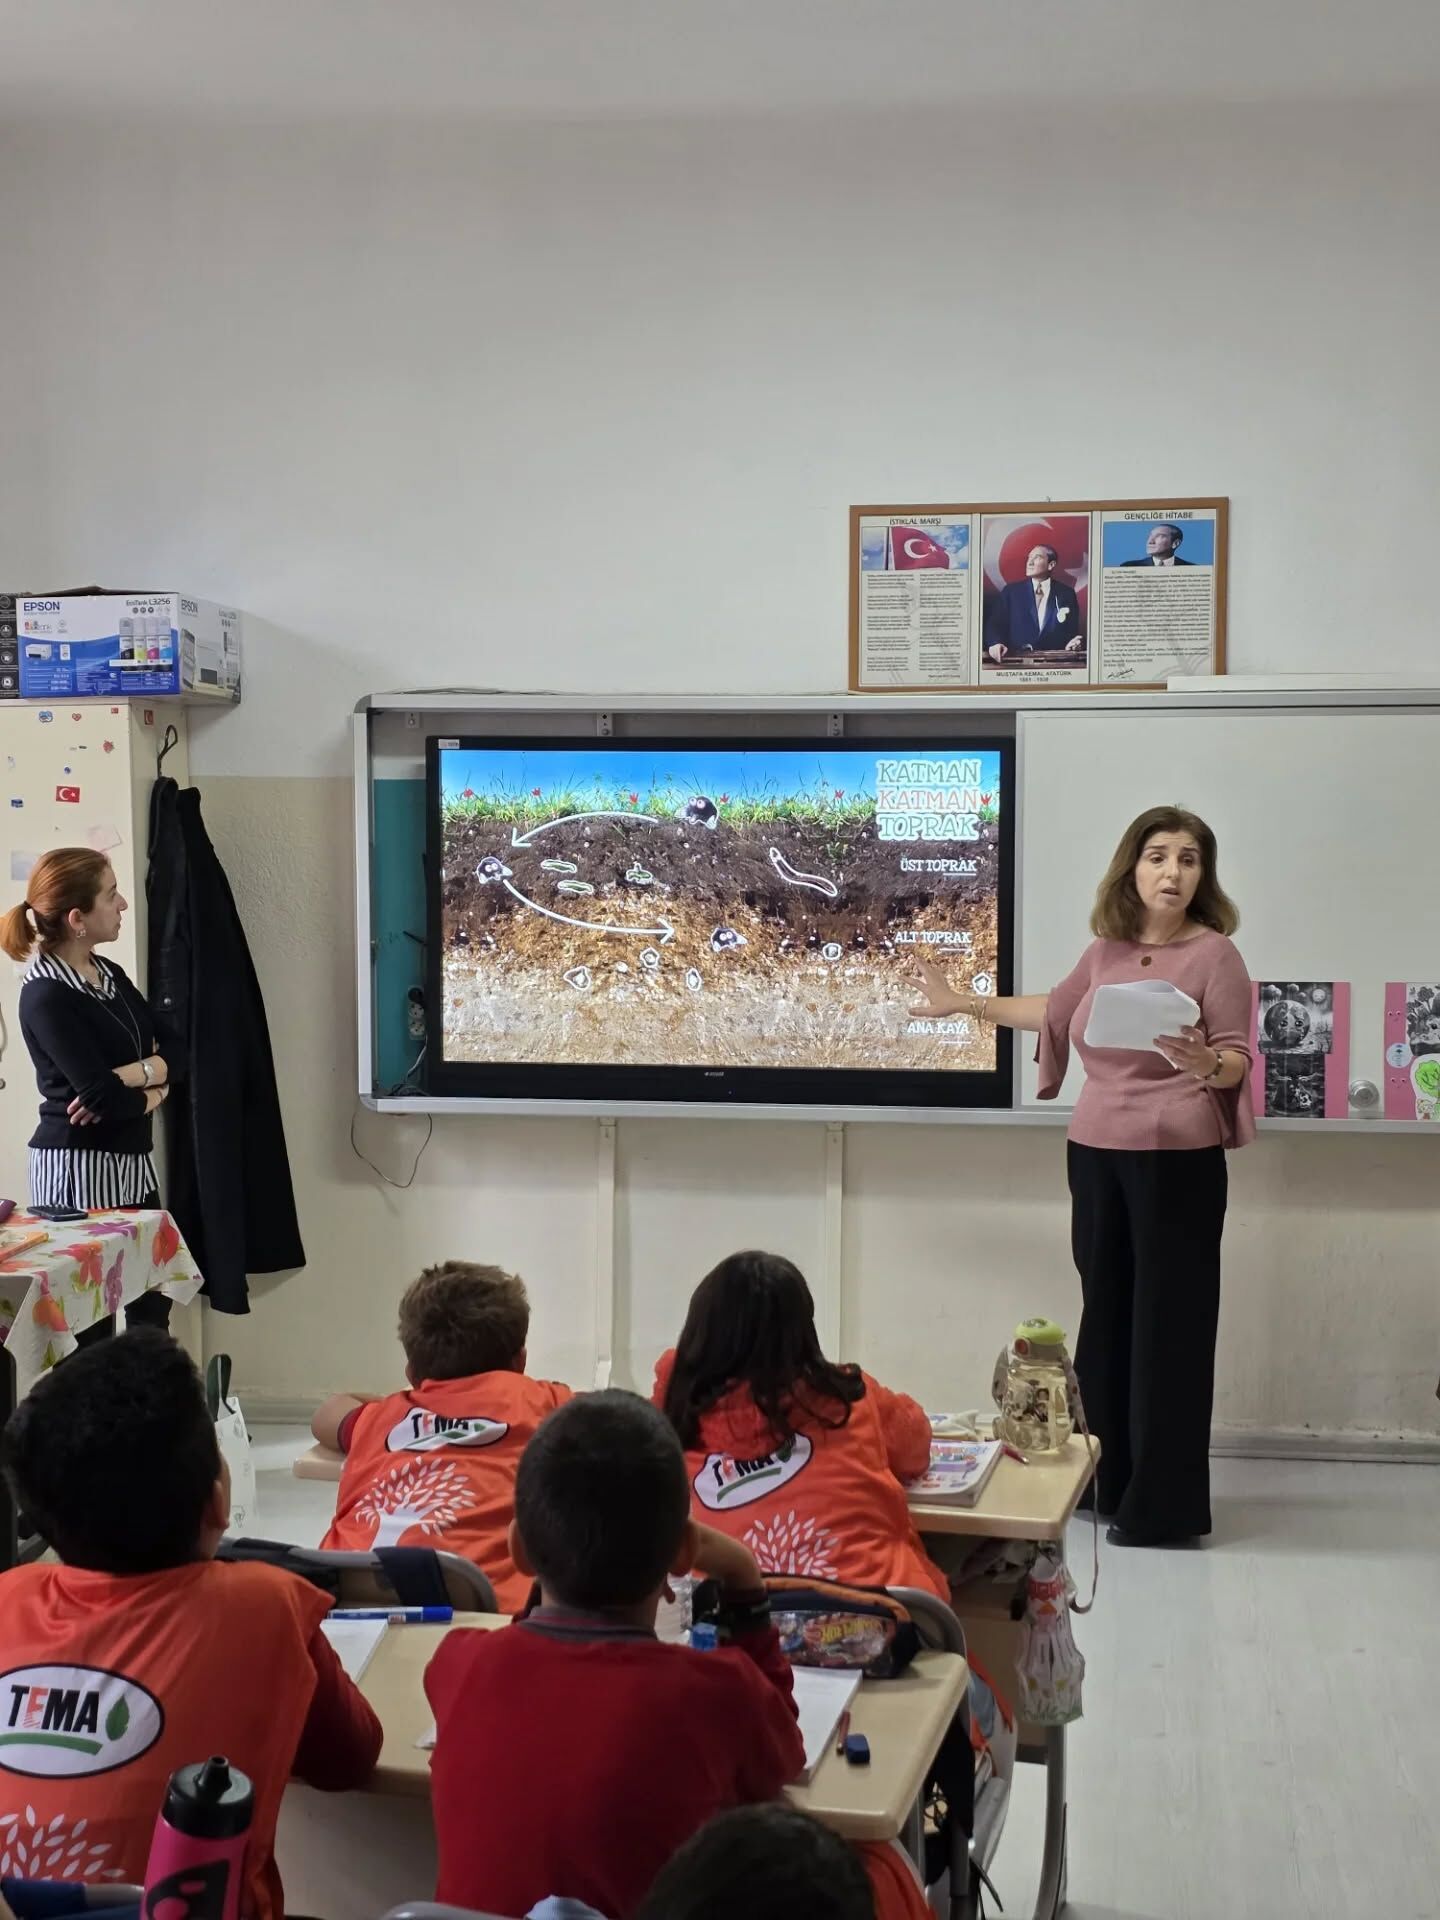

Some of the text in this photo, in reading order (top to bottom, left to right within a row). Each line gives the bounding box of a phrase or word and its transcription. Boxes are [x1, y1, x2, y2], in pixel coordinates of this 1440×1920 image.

[23, 601, 60, 611] EPSON
[181, 599, 198, 614] EPSON
[878, 761, 979, 784] KATMAN
[878, 788, 979, 811] KATMAN
[878, 815, 979, 838] TOPRAK
[900, 857, 978, 872] ÜST TOPRAK
[895, 930, 973, 943] ALT TOPRAK
[906, 1020, 970, 1034] ANA KAYA
[411, 1412, 469, 1439] TEMA
[8, 1684, 100, 1733] TEMA
